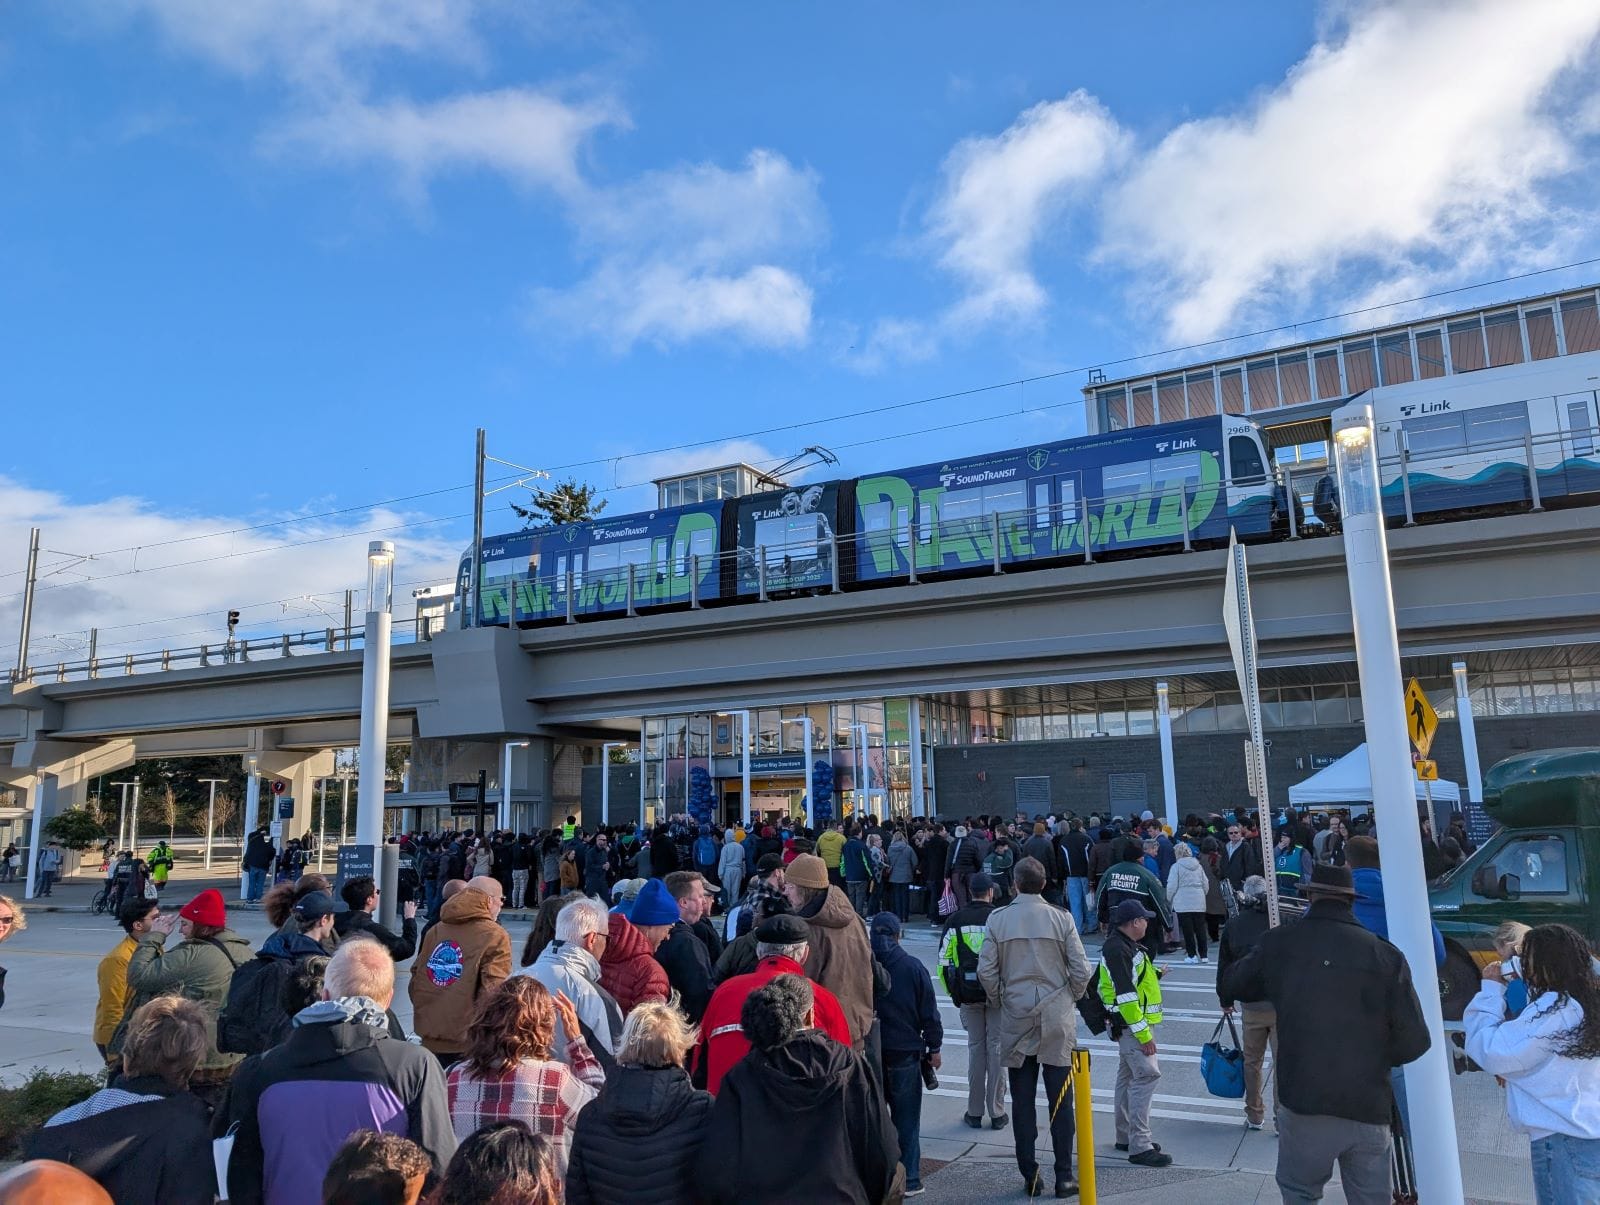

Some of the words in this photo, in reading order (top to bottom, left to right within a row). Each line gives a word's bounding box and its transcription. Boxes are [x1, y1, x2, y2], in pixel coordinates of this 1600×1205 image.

[1421, 399, 1451, 414] Link
[1227, 425, 1250, 435] 296B
[1172, 438, 1198, 451] Link
[1055, 450, 1220, 551] WORLD
[763, 508, 781, 519] Link
[491, 547, 505, 557] Link
[1112, 873, 1140, 882] TRANSIT
[1111, 880, 1138, 889] SECURITY
